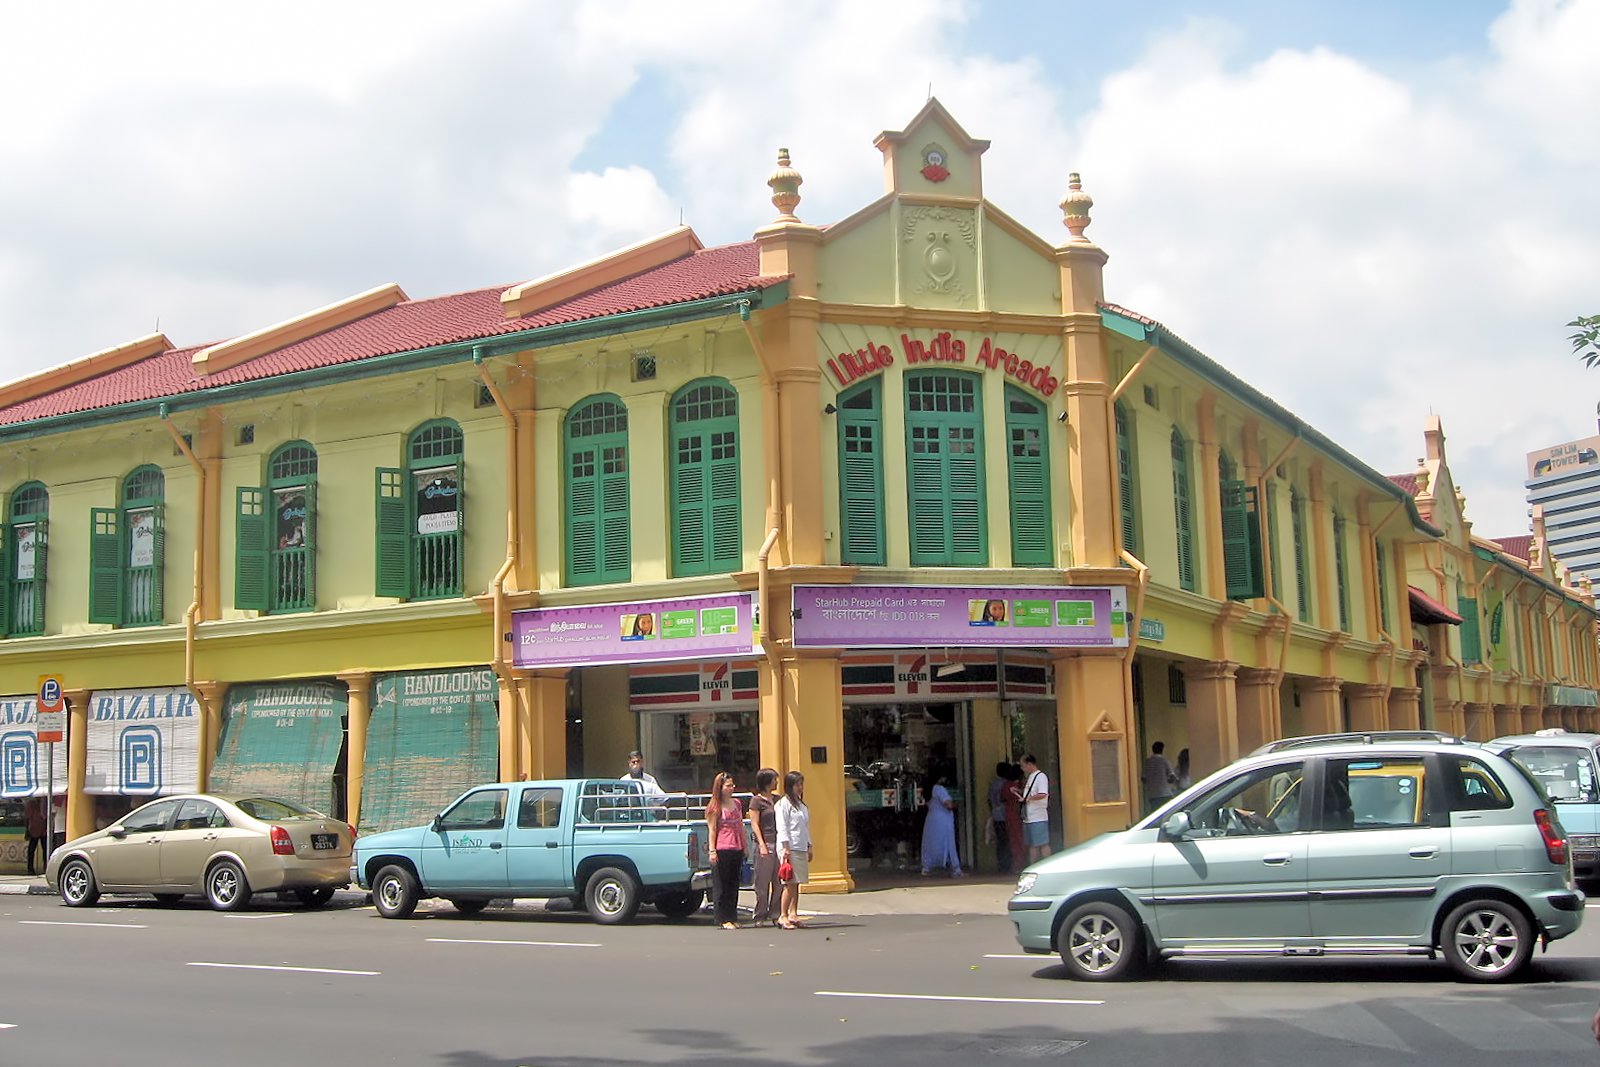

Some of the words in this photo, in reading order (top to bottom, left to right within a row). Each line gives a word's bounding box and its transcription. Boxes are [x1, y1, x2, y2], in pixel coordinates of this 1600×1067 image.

[826, 341, 894, 386] Little
[900, 332, 966, 364] India
[975, 337, 1059, 397] Arcade
[1551, 454, 1577, 468] TOWER
[815, 597, 849, 608] StarHub
[851, 597, 882, 609] Prepaid
[884, 597, 904, 607] Card
[676, 617, 694, 626] GREEN
[892, 611, 907, 620] IDD
[909, 611, 925, 620] 018
[404, 670, 492, 695] HANDLOOMS
[45, 681, 57, 700] P
[254, 687, 334, 706] HANDLOOMS
[95, 693, 195, 720] BAZAAR
[439, 695, 449, 704] THE
[452, 833, 483, 847] ISLND
